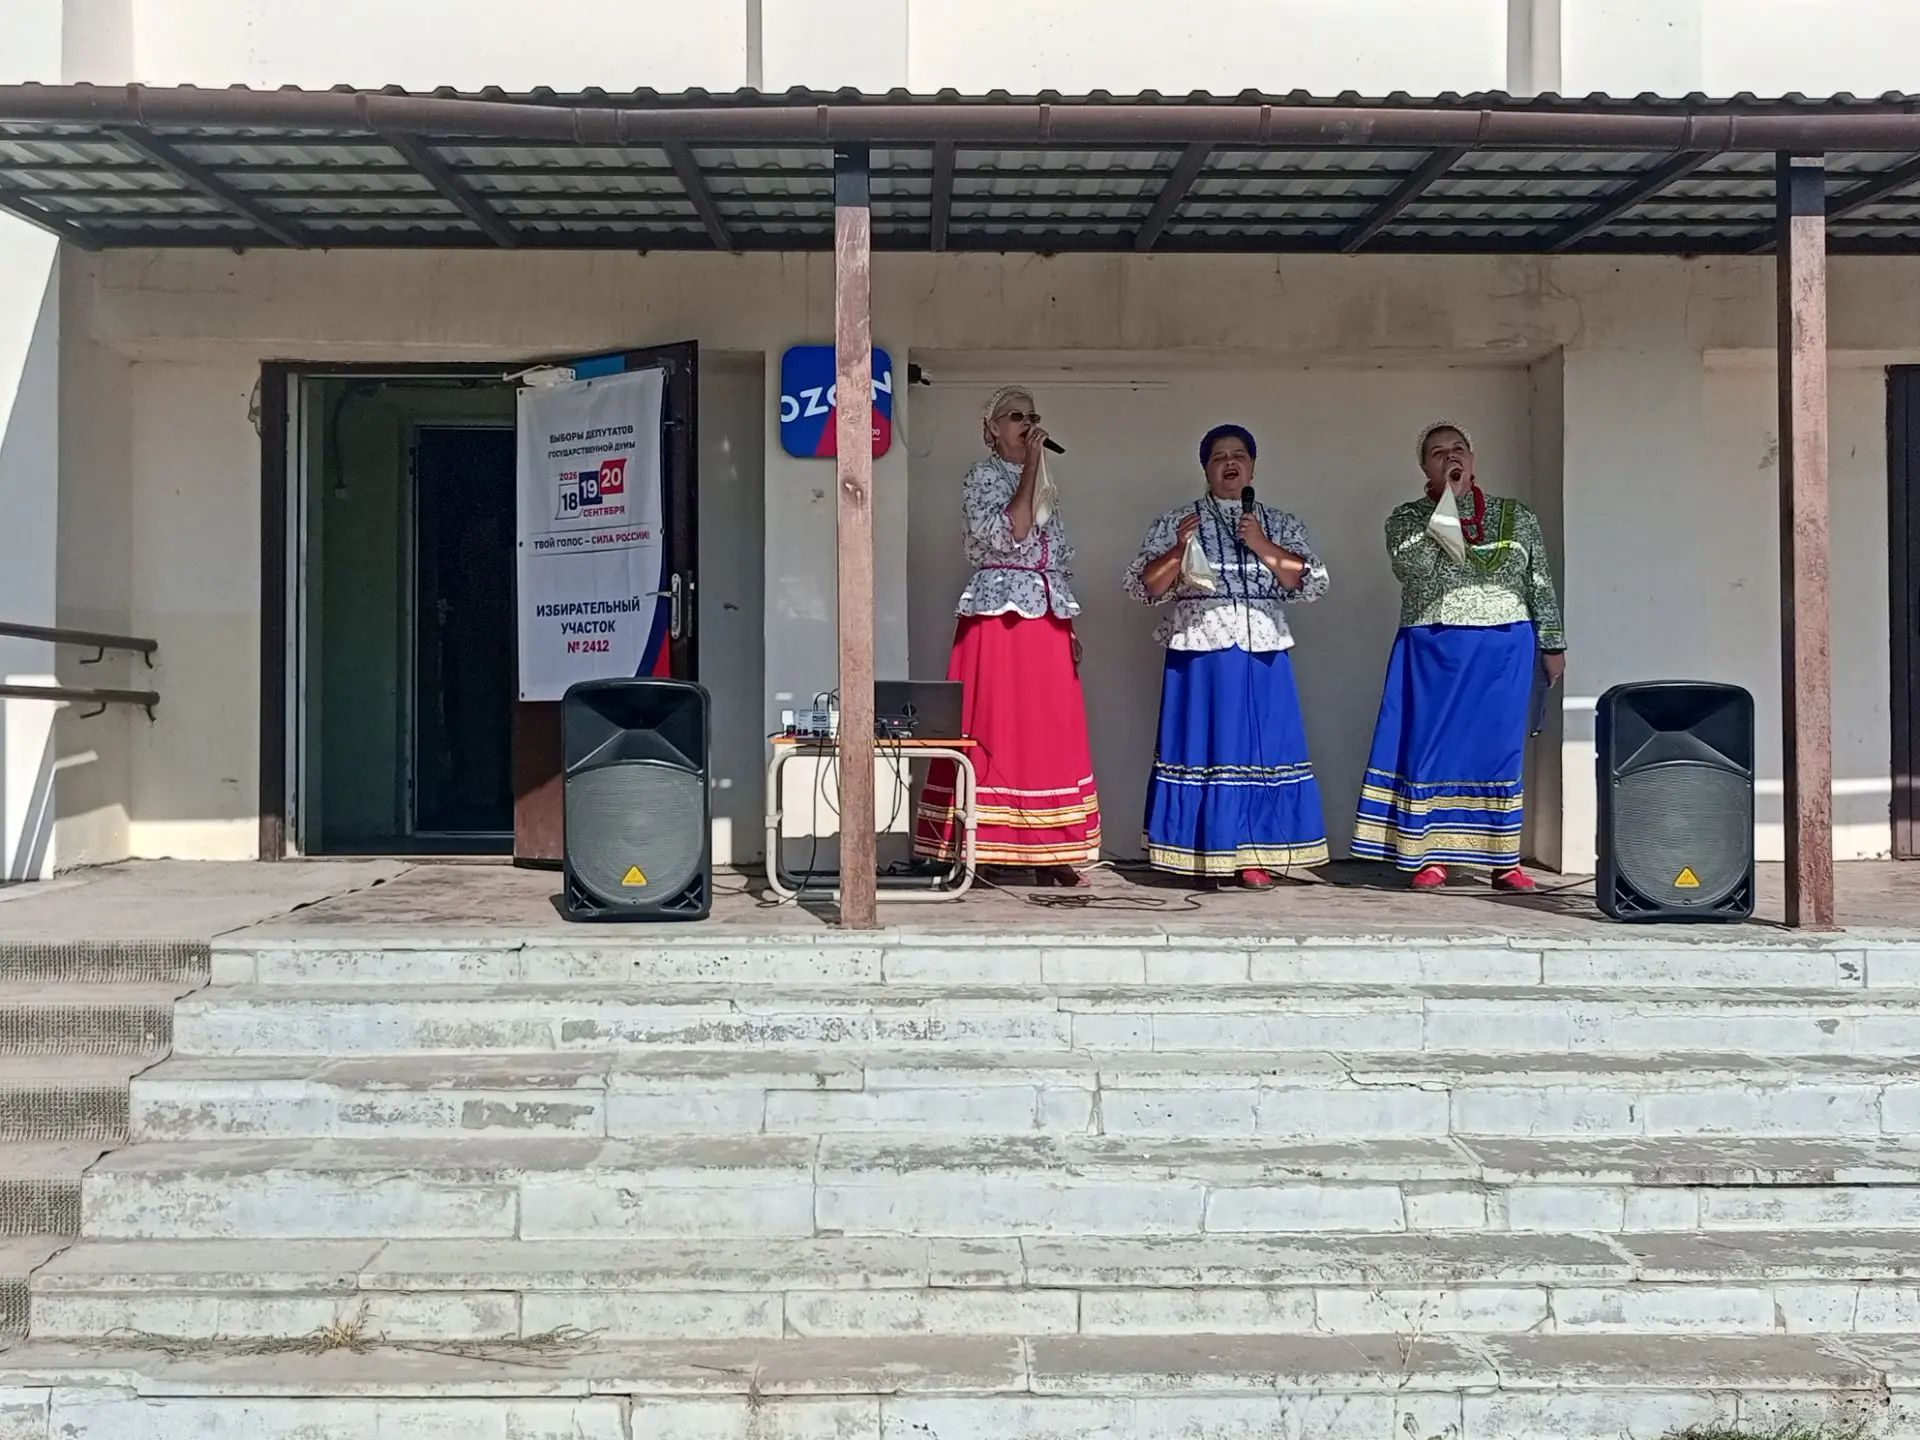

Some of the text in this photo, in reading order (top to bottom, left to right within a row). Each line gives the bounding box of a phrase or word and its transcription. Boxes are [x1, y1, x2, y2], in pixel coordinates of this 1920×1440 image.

[549, 425, 634, 444] ВЫБОРЫ ДЕПУТАТОВ
[548, 440, 636, 459] ГОСУДАРСТВЕННОЙ ДУМЫ
[559, 471, 577, 481] 2026
[562, 467, 621, 511] 18 19 20
[583, 505, 625, 518] СЕНТЯБРЯ
[533, 537, 555, 550] ТВОЙ
[556, 536, 584, 548] ГОЛОС
[591, 534, 615, 544] СИЛА
[536, 595, 640, 617] ИЗБИРАТЕЛЬНЫЙ
[561, 620, 616, 635] УЧАСТОК
[567, 640, 610, 654] № 2412
